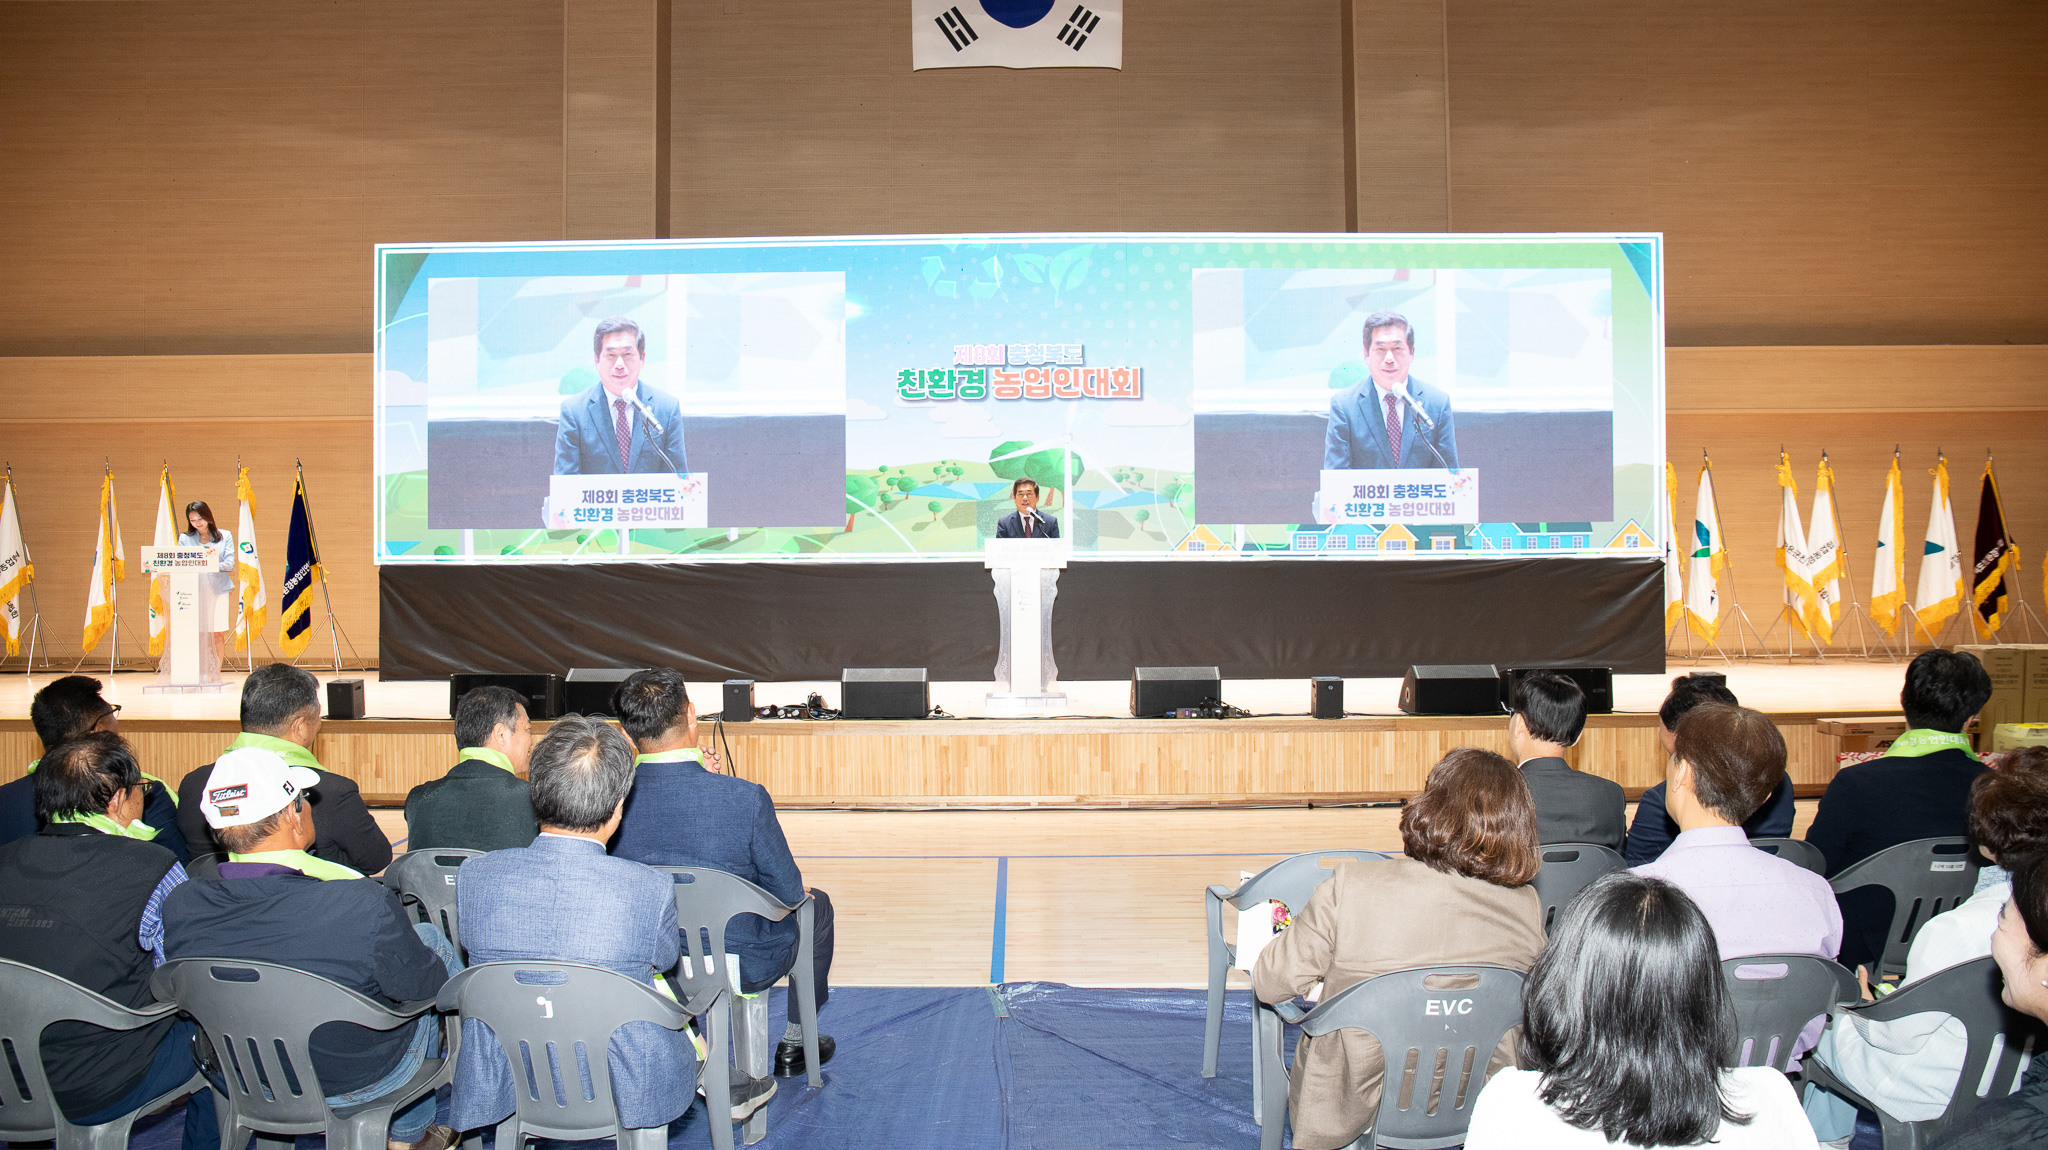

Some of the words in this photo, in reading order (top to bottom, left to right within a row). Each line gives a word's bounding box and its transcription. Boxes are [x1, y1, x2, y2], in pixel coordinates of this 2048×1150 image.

[954, 344, 1005, 365] 제8회
[1007, 344, 1083, 365] 충청북도
[897, 367, 985, 400] 친환경
[992, 366, 1142, 399] 농업인대회
[581, 489, 618, 504] 제8회
[622, 488, 675, 503] 충청북도
[1352, 484, 1389, 499] 제8회
[1393, 484, 1447, 499] 충청북도
[573, 507, 613, 522] 친환경
[617, 506, 684, 521] 농업인대회
[1344, 502, 1385, 517] 친환경
[1388, 501, 1455, 517] 농업인대회
[152, 559, 173, 567] 친환경
[174, 559, 208, 567] 농업인대회
[211, 788, 246, 803] Titleist
[444, 874, 457, 886] E
[1425, 998, 1473, 1016] EVC
